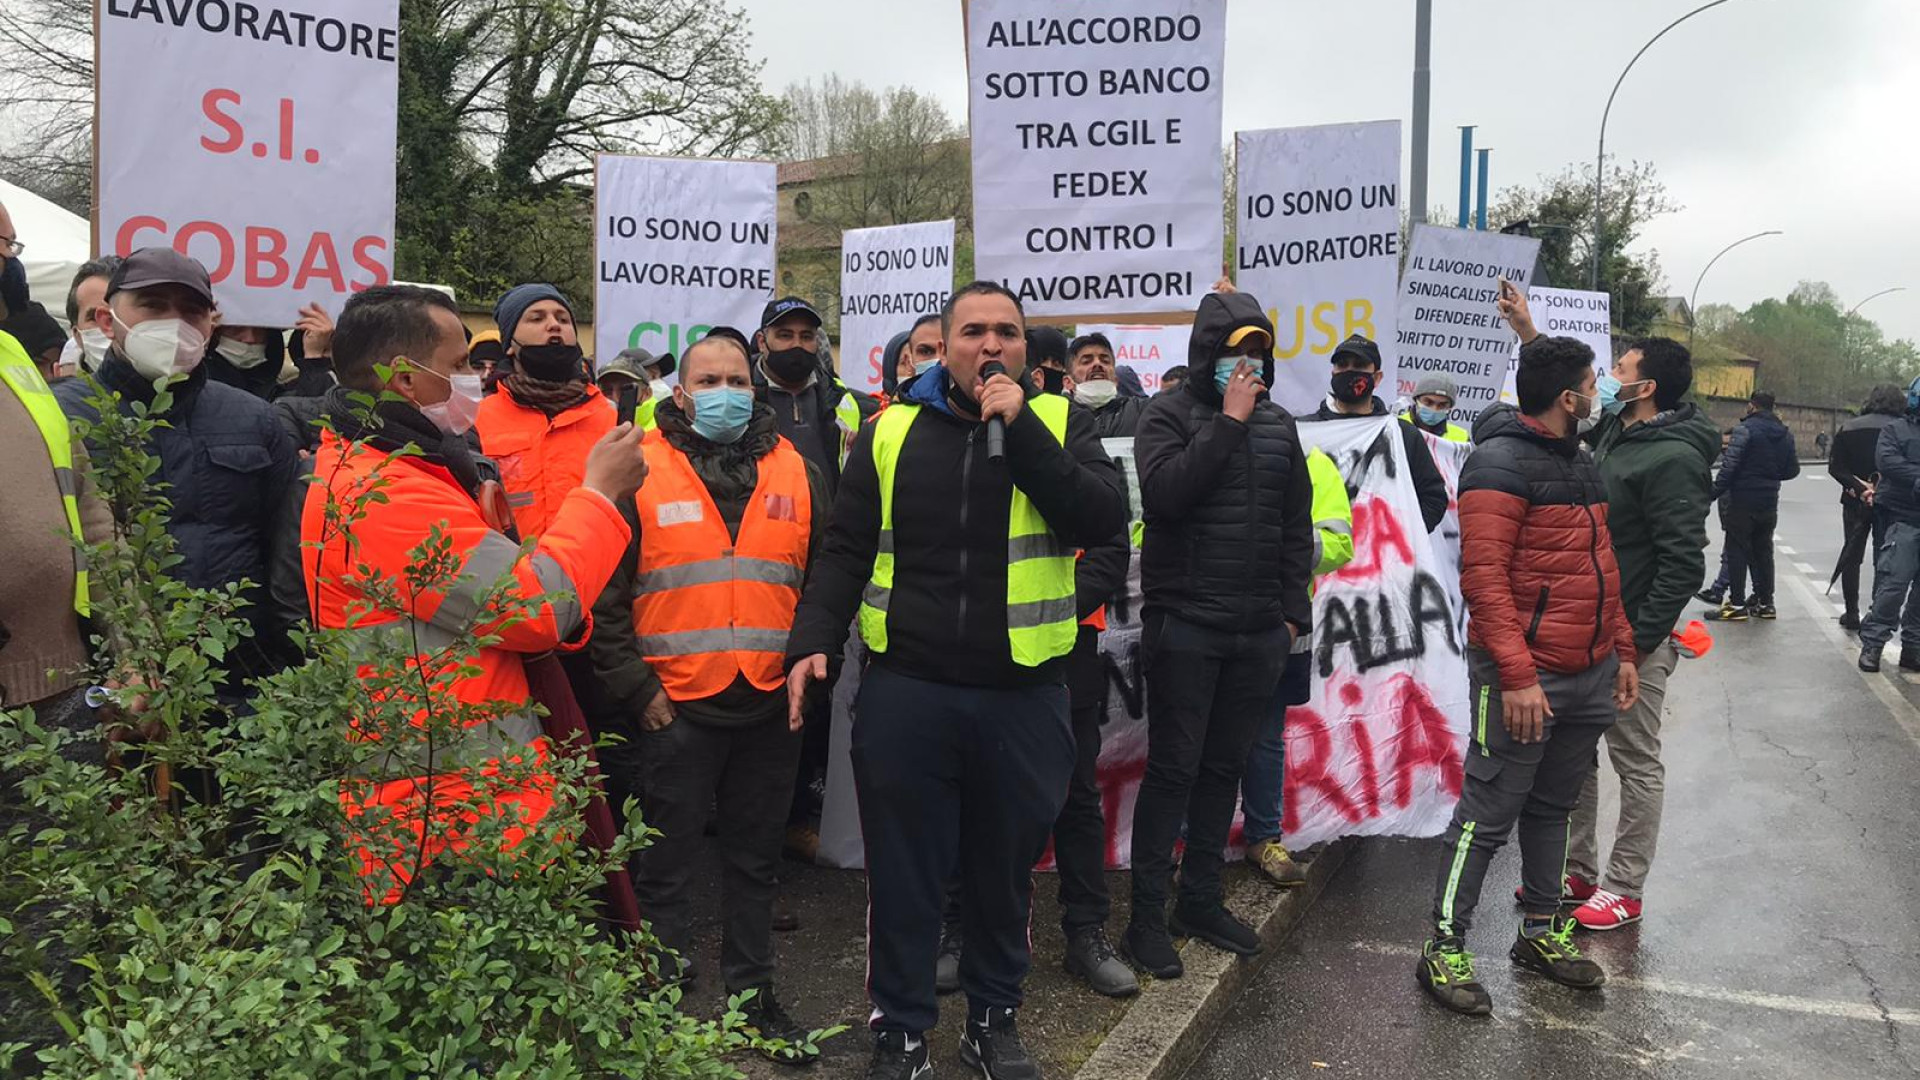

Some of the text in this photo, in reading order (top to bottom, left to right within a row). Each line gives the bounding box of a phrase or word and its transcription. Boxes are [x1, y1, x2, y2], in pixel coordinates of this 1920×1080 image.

[987, 15, 1202, 48] ALL'ACCORDO
[985, 66, 1211, 100] SOTTO BANCO
[200, 88, 320, 164] S.I.
[1016, 118, 1181, 150] TRA CGIL E
[1053, 170, 1148, 199] FEDEX
[1247, 184, 1396, 219] IO SONO UN
[608, 215, 769, 245] IO SONO UN
[1026, 223, 1173, 253] CONTRO I
[845, 245, 949, 273] IO SONO UN
[1239, 232, 1397, 270] LAVORATORE
[1413, 256, 1425, 270] IL
[1429, 258, 1484, 278] LAVORO
[1505, 269, 1526, 282] UN
[1546, 295, 1584, 309] SONO
[1588, 299, 1608, 311] UN
[1268, 299, 1376, 360] USB
[1415, 307, 1503, 330] DIFENDERE IL
[1548, 318, 1609, 335] ORATORE
[1116, 345, 1160, 360] ALLA
[1448, 335, 1464, 349] DI
[1467, 337, 1505, 354] TUTTI
[1398, 355, 1481, 376] LAVORATORI
[1483, 363, 1493, 376] E
[1318, 570, 1460, 677] ALLA
